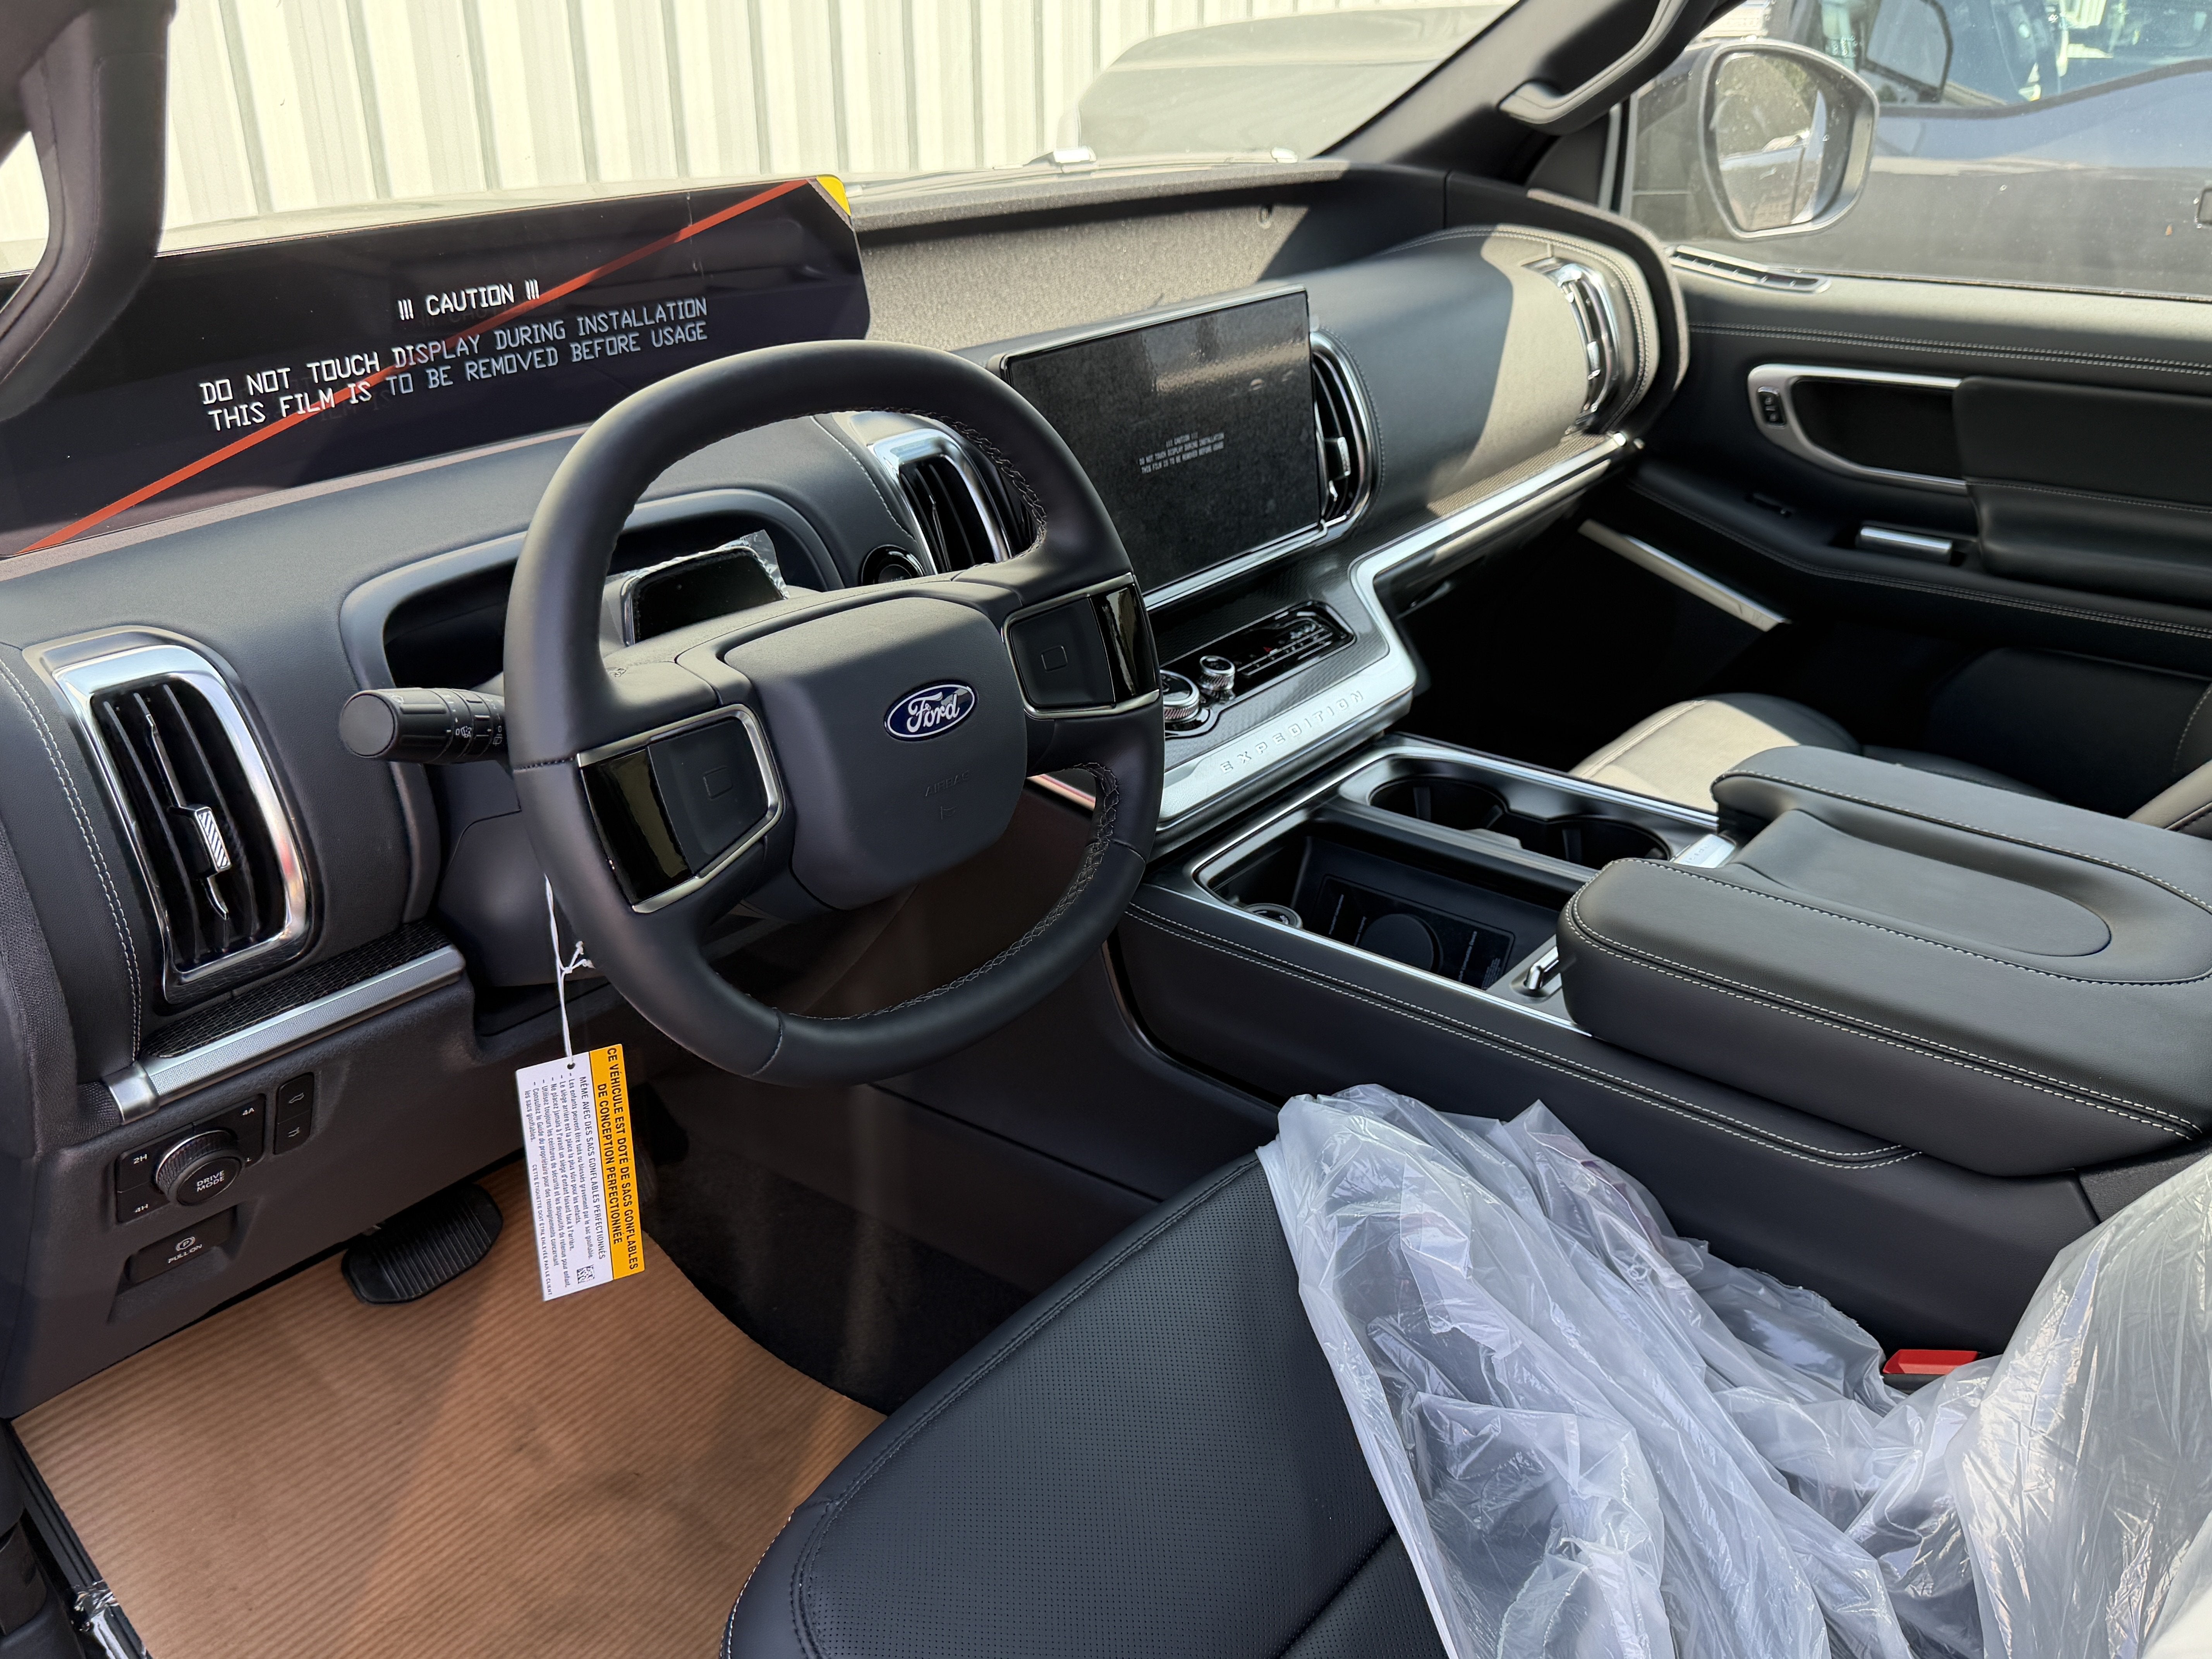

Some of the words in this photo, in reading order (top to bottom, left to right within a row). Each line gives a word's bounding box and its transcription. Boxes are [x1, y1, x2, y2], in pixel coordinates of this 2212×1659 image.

[426, 282, 514, 316] CAUTION
[199, 378, 234, 405] DO
[247, 368, 291, 396] NOT
[306, 351, 381, 384] TOUCH
[391, 335, 480, 368] DISPLAY
[493, 320, 566, 350] DURING
[577, 296, 708, 337] INSTALLATION
[208, 401, 266, 431] THIS
[280, 388, 336, 418] FILM
[349, 381, 373, 404] IS
[385, 373, 414, 396] TO
[426, 365, 454, 389] BE
[465, 346, 558, 381] REMOVED
[570, 331, 641, 362] BEFORE
[651, 321, 708, 348] USAGE
[907, 692, 960, 733] Ford
[1220, 690, 1363, 774] EXPEDITION
[607, 1048, 618, 1062] CE
[579, 1076, 589, 1100] MÊME
[597, 1083, 608, 1098] DE
[609, 1063, 623, 1114] VÉHICULE
[242, 1107, 256, 1116] 4A
[582, 1101, 591, 1120] AVEC
[584, 1121, 593, 1136] DES
[599, 1100, 615, 1164] CONCEPTION
[615, 1116, 625, 1134] EST
[133, 1153, 148, 1164] 2H
[586, 1137, 595, 1156] SACS
[617, 1137, 630, 1164] DOTÉ
[197, 1170, 225, 1187] DRIVE
[197, 1176, 225, 1192] MODE
[588, 1158, 600, 1203] GONFLABLES
[620, 1166, 630, 1181] DE
[606, 1166, 624, 1245] PERFECTIONNÉE
[622, 1182, 633, 1207] SACS
[134, 1203, 149, 1214] 4H
[593, 1204, 607, 1260] PERFECTIONNÉS
[624, 1209, 638, 1270] GONFLABLES
[168, 1251, 189, 1264] PULL
[189, 1243, 203, 1253] ON
